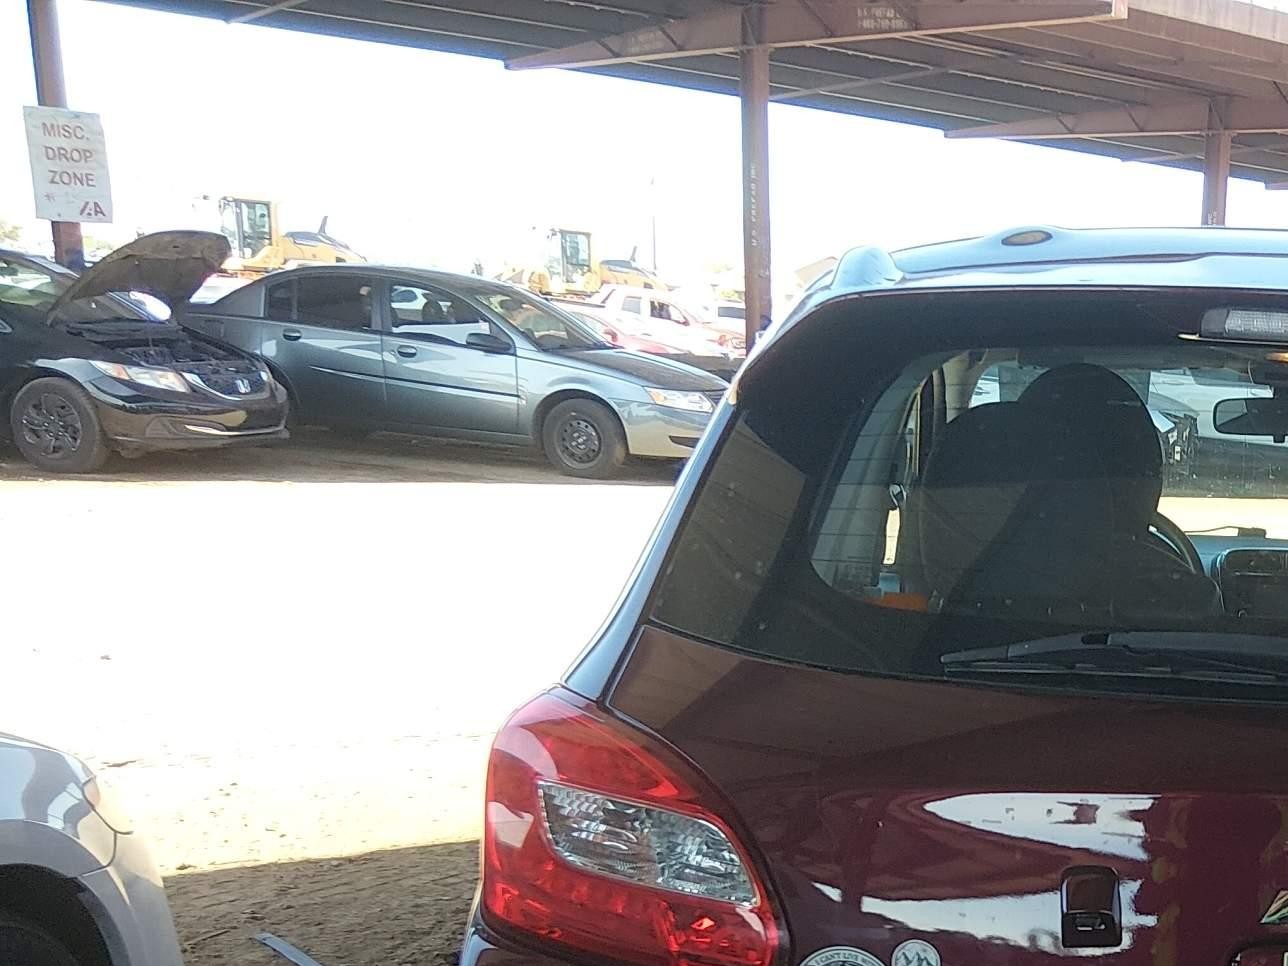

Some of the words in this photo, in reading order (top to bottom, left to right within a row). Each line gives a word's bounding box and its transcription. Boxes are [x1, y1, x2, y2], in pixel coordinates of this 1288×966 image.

[42, 122, 90, 141] MISC.
[43, 145, 94, 163] DROP
[48, 169, 96, 188] ZONE
